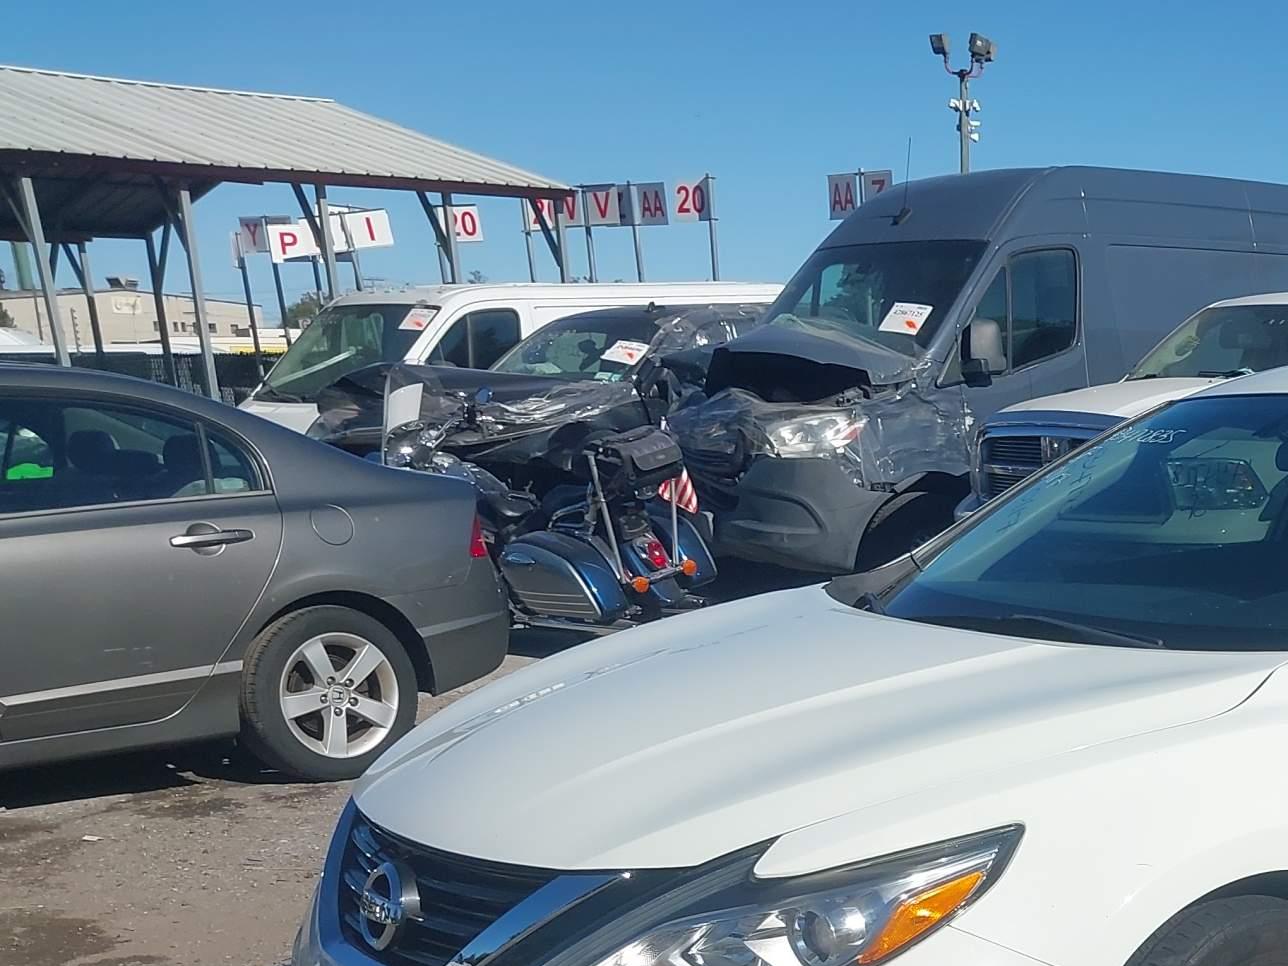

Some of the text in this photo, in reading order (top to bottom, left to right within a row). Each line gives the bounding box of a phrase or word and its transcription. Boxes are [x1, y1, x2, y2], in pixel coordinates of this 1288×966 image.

[592, 191, 610, 219] V
[641, 190, 666, 218] AA
[676, 185, 706, 214] 20
[832, 181, 856, 212] AA
[245, 223, 258, 247] Y
[278, 231, 298, 255] P
